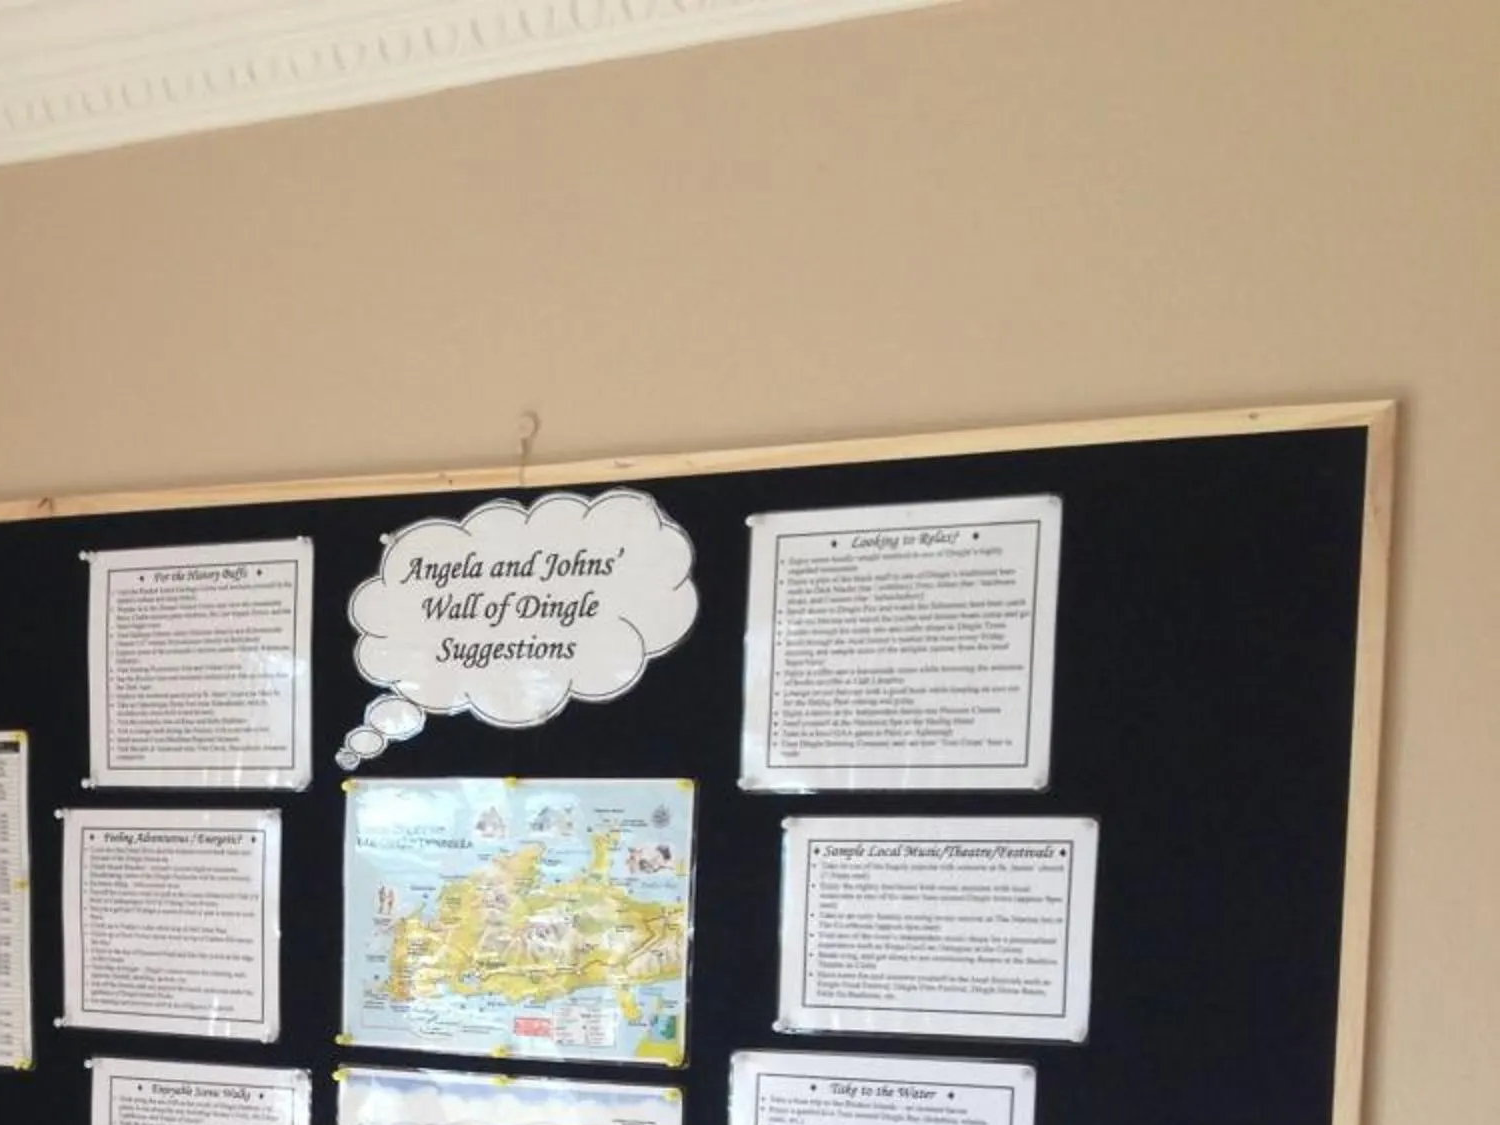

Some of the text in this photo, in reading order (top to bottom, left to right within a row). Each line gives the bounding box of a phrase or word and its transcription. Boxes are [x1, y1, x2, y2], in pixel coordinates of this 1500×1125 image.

[851, 535, 899, 551] Looking
[902, 535, 916, 547] to
[154, 567, 248, 583] For the History Buffs
[401, 547, 625, 588] Angela and Johns'
[421, 590, 599, 627] Wall of Dingle
[436, 635, 577, 668] Suggestions
[823, 845, 865, 860] Sample
[867, 844, 901, 858] Local
[829, 1082, 937, 1099] Take to the Water
